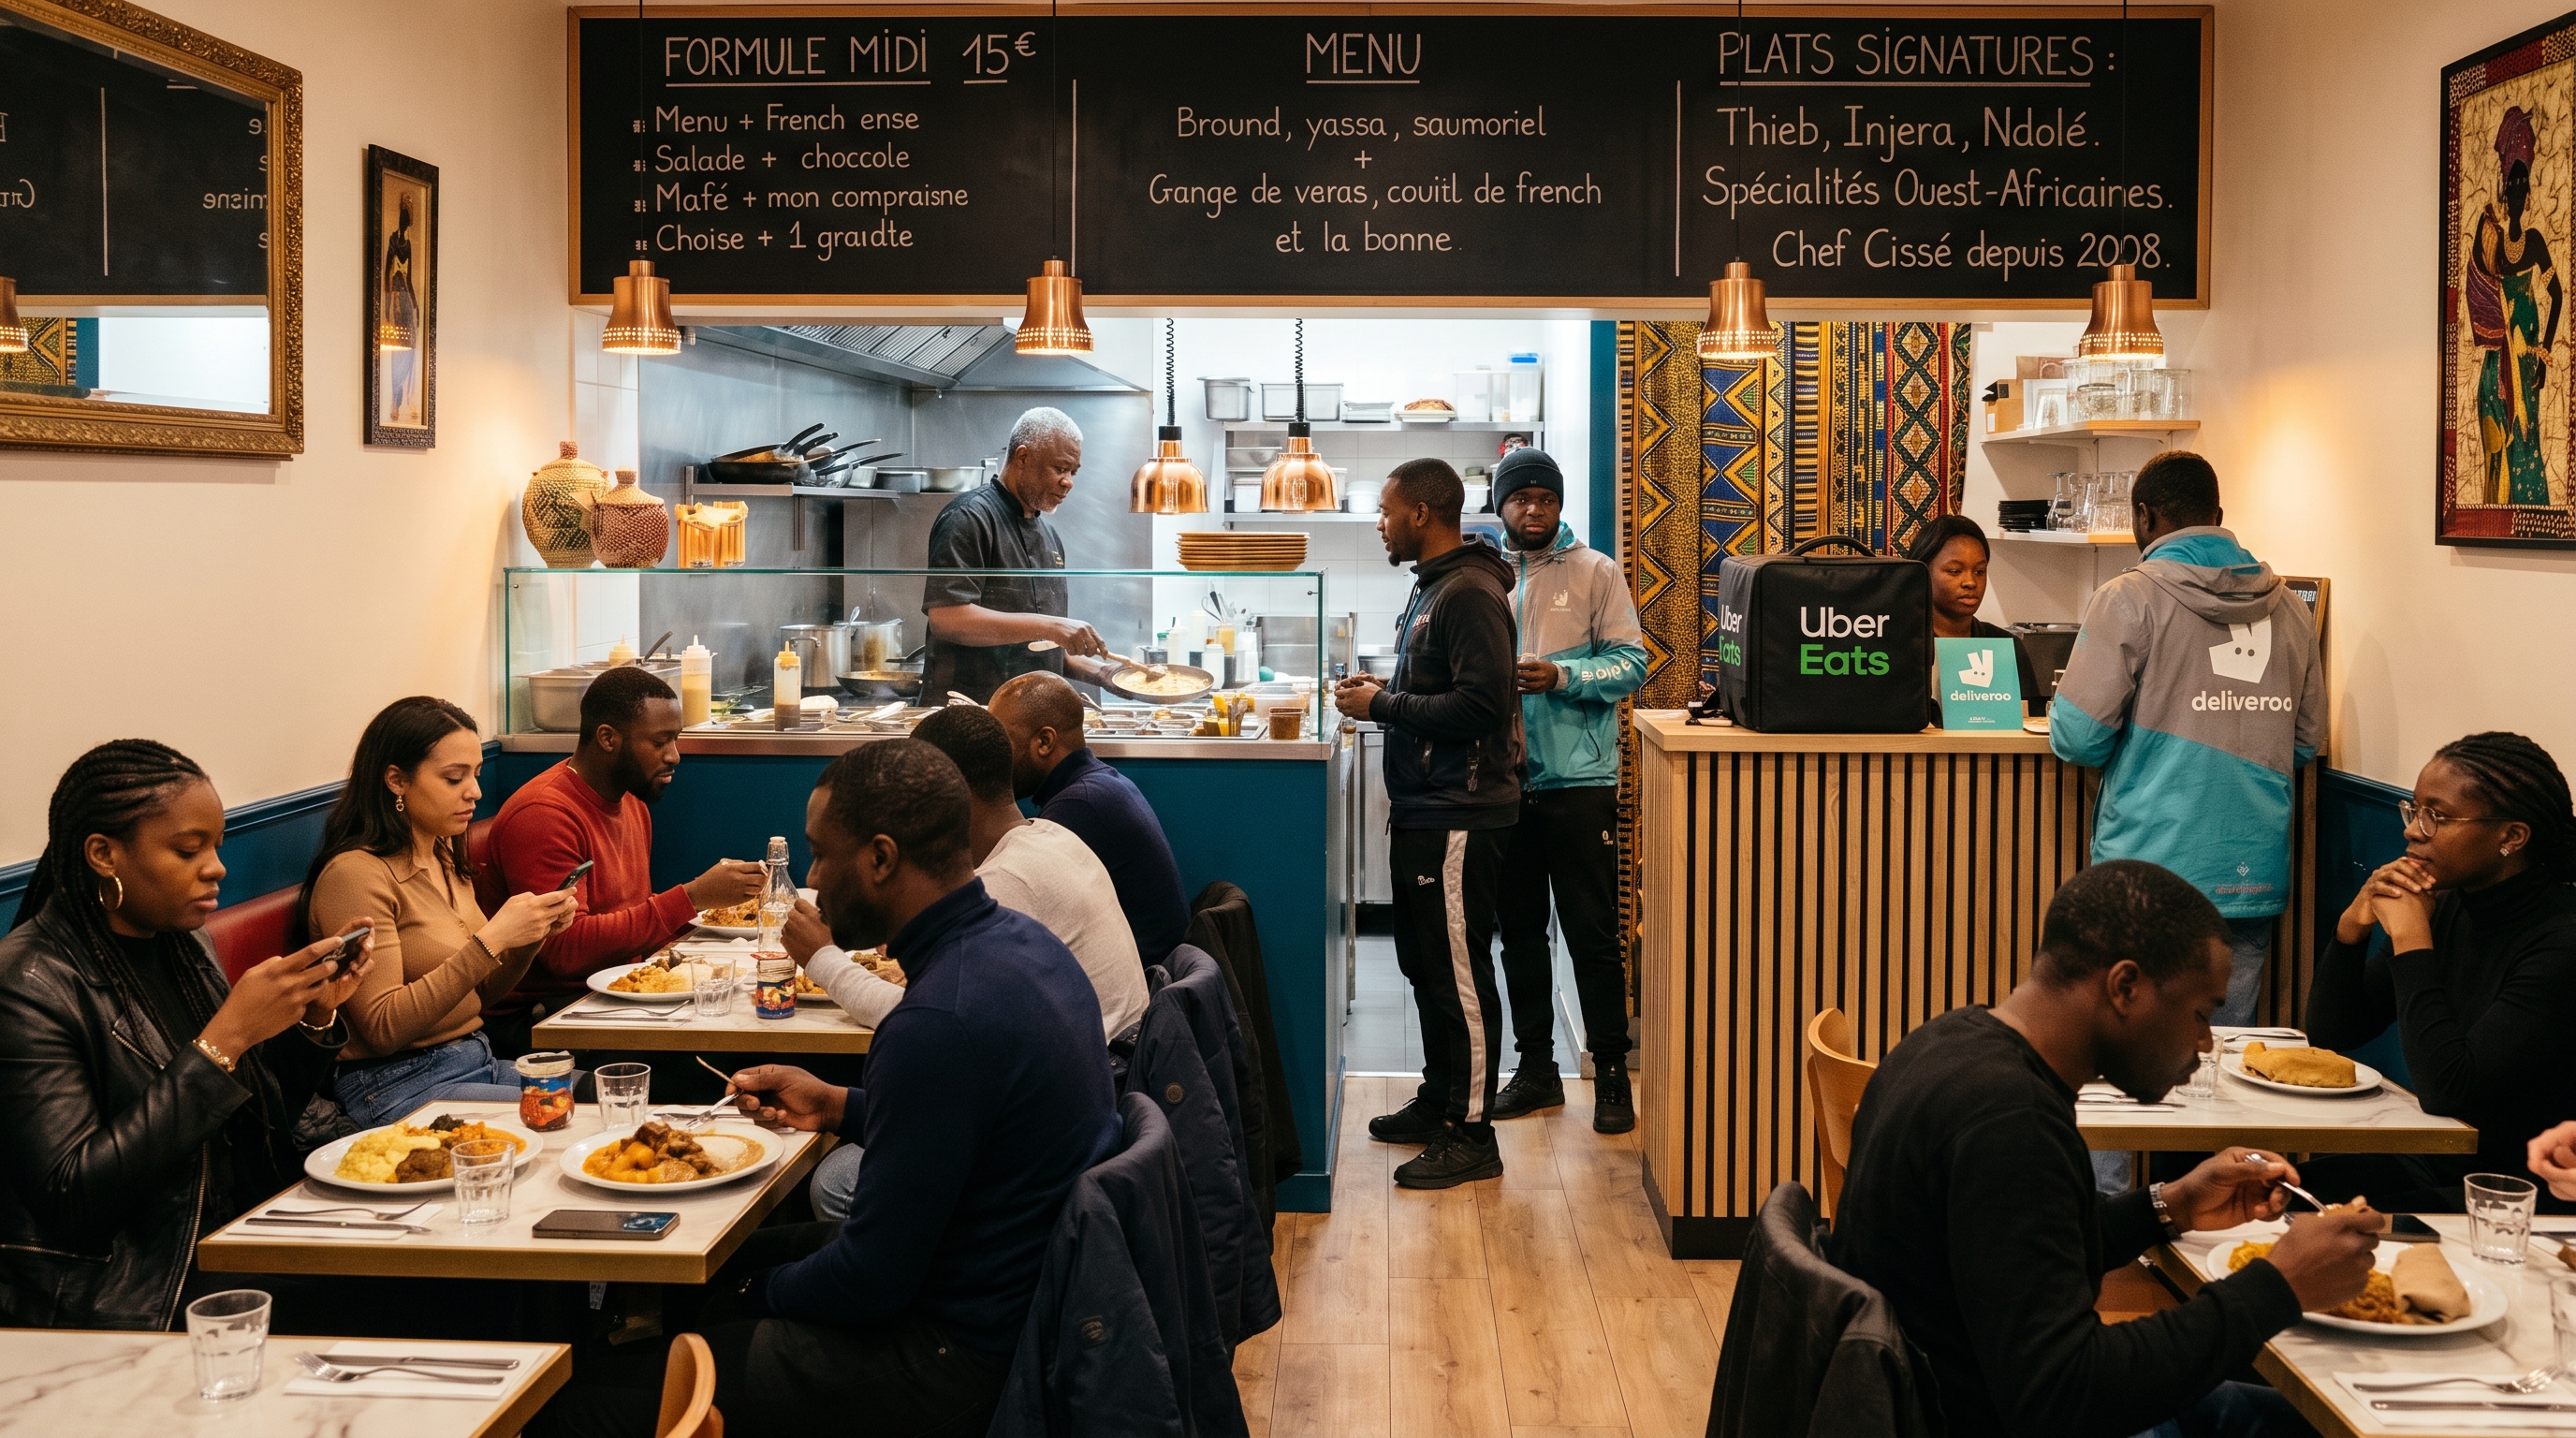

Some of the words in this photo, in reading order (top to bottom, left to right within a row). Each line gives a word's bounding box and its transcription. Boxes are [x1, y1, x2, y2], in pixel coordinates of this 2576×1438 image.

[666, 37, 827, 77] FORMULE
[1306, 32, 1421, 75] MENU
[1719, 31, 1835, 75] PLATS
[656, 105, 727, 133] Menu
[767, 103, 845, 131] French
[860, 112, 920, 130] ense
[1178, 106, 1292, 142] Bround,
[1412, 105, 1547, 137] saumoriel
[1716, 105, 1830, 153] Thieb,
[654, 143, 746, 173] Salade
[801, 141, 910, 169] choccole
[656, 181, 729, 213] Mafé
[768, 191, 820, 208] mon
[831, 183, 969, 216] compraisne
[1149, 173, 1237, 219] Gange
[1251, 172, 1282, 204] de
[1473, 171, 1506, 204] de
[1515, 170, 1602, 204] french
[1702, 165, 1881, 221] Spécialités
[656, 224, 745, 252] Choise
[789, 220, 807, 249] 1
[1275, 220, 1305, 253] et
[1324, 220, 1351, 253] la
[1772, 227, 1852, 268] Chef
[1864, 227, 1953, 269] Cissé
[1967, 229, 2064, 282] depuis
[1720, 603, 1743, 634] Uber
[1800, 606, 1890, 638] Uber
[1800, 643, 1890, 676] Eats
[1950, 689, 2012, 701] deliveroo
[2191, 689, 2292, 712] deliveroo
